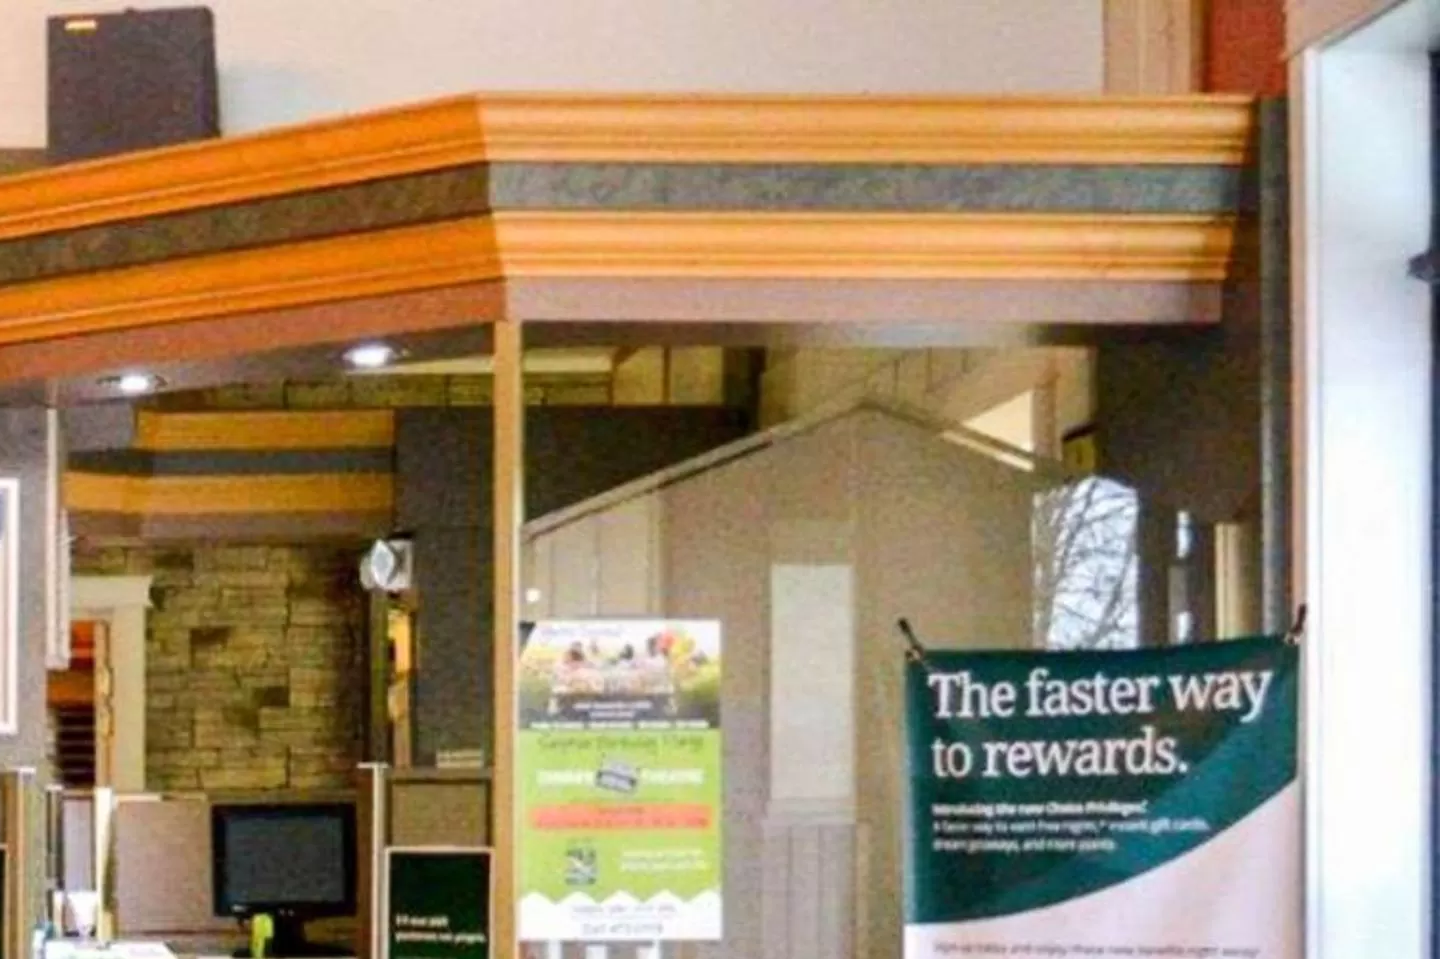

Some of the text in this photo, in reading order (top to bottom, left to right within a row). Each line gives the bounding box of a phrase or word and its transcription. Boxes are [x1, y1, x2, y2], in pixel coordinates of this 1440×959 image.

[927, 668, 1274, 723] The faster way
[932, 726, 1189, 778] to rewards.
